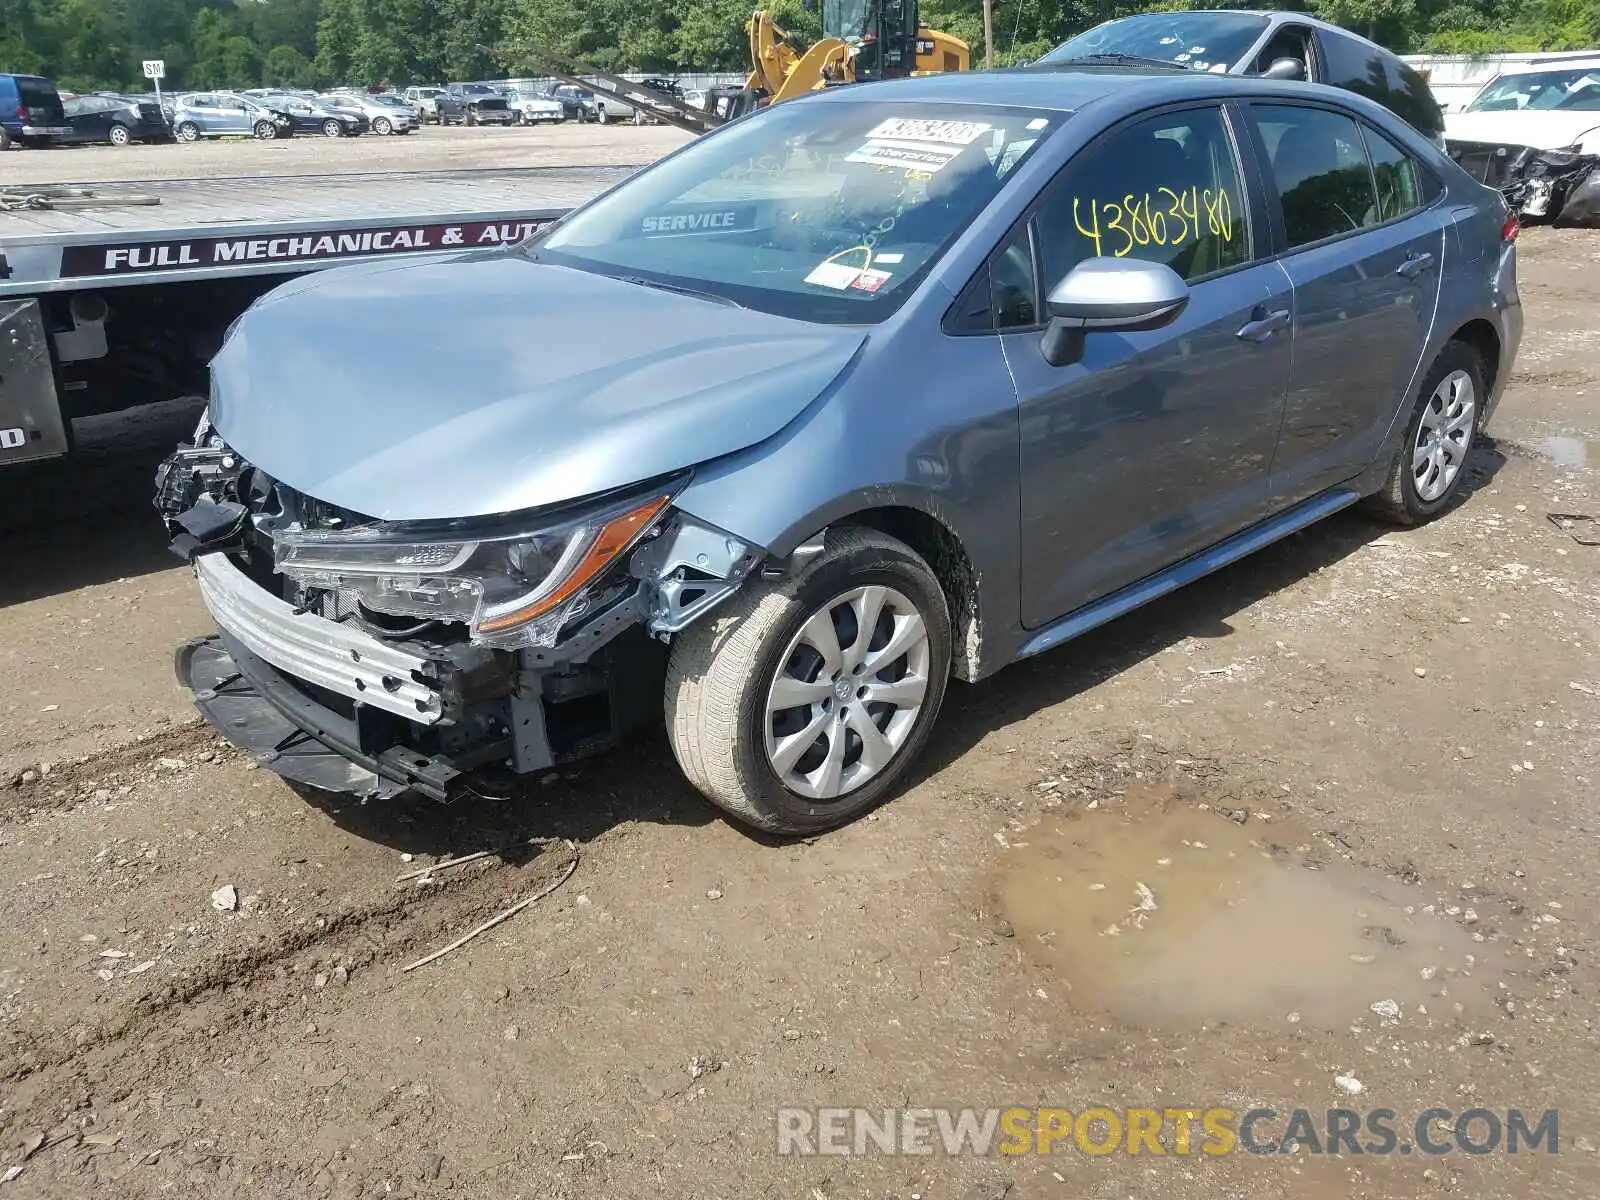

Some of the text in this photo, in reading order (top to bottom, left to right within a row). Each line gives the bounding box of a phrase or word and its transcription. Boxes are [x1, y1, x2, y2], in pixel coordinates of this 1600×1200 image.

[145, 63, 161, 75] SM
[641, 212, 737, 232] SERVICE
[1073, 186, 1232, 257] 43863480
[105, 245, 200, 270] FULL
[213, 229, 432, 262] MECHANICAL
[441, 227, 465, 245] &
